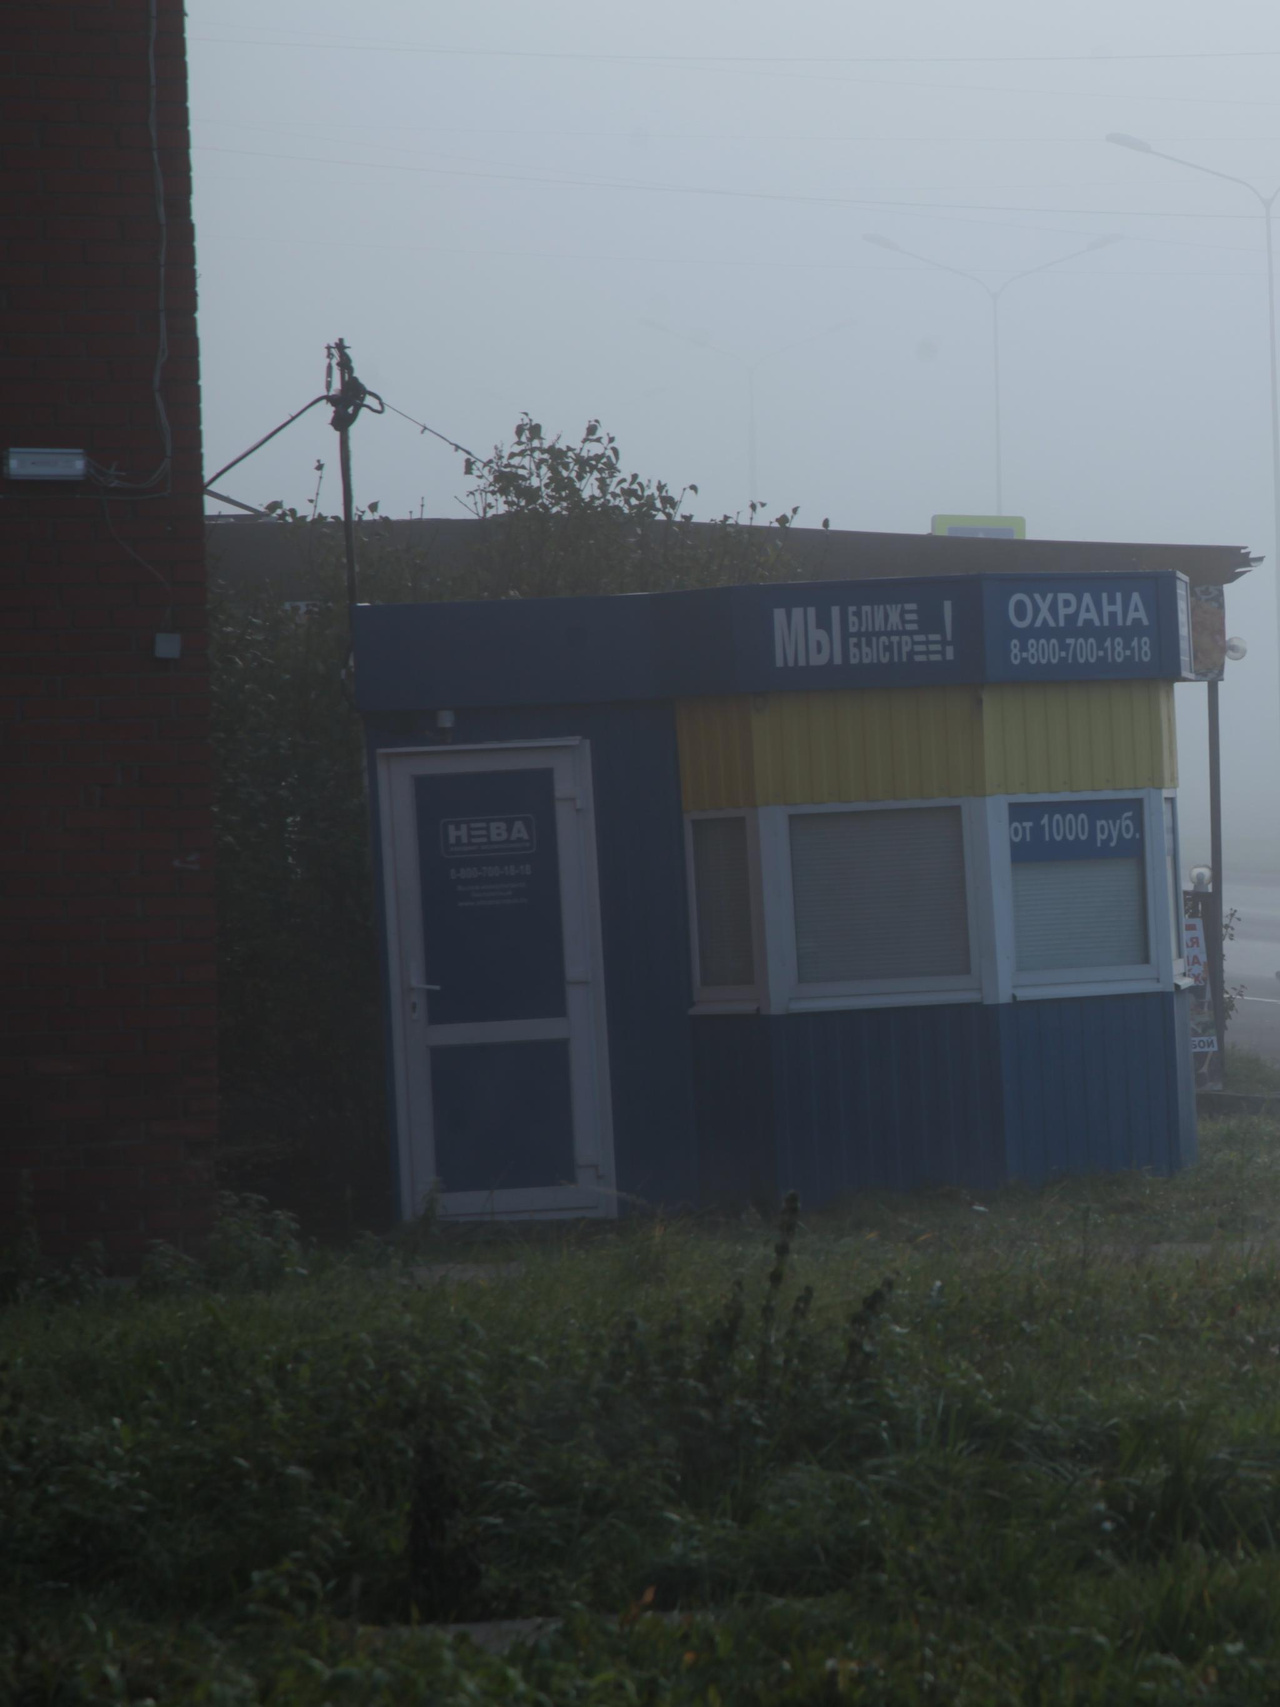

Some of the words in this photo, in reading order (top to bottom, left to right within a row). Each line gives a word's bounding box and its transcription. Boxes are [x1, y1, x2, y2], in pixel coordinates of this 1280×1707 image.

[1008, 591, 1149, 629] ОХРАНА
[774, 604, 842, 668] МЫ
[848, 602, 919, 633] БЛИЖЕ
[1010, 635, 1151, 665] 8-800-700-18-18
[447, 820, 530, 845] НЕВА
[1010, 821, 1034, 842] от
[1040, 813, 1089, 842] 1000
[1096, 811, 1140, 847] руб.
